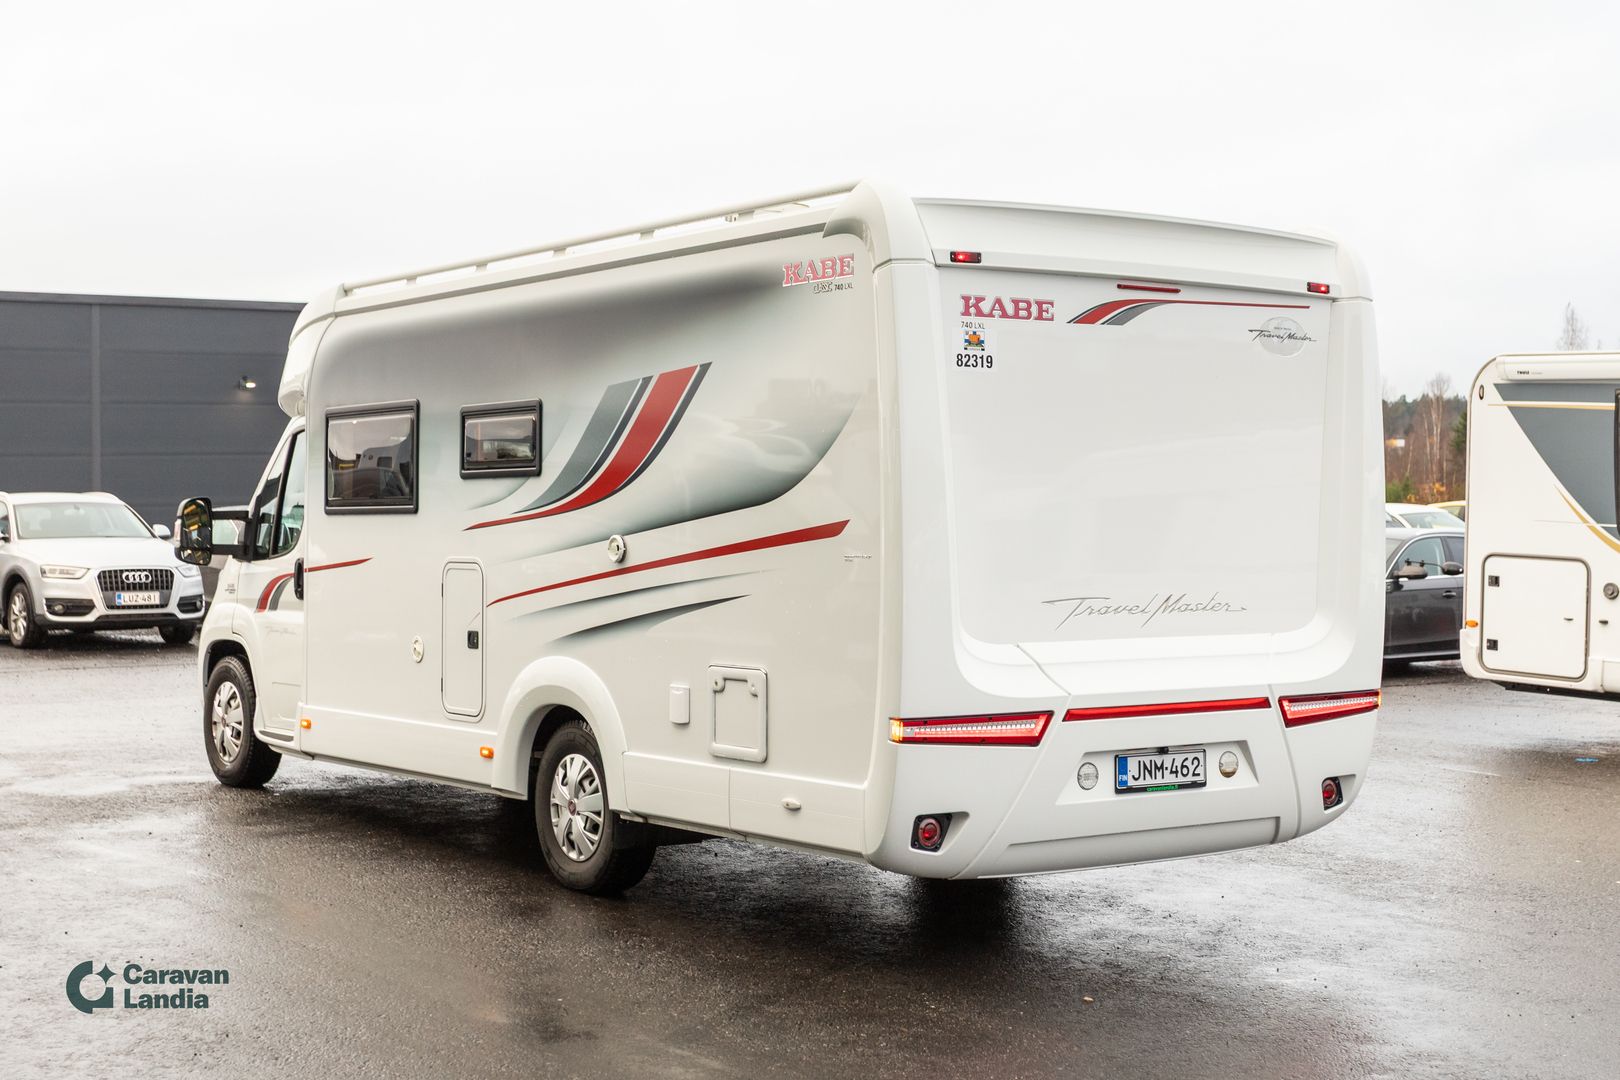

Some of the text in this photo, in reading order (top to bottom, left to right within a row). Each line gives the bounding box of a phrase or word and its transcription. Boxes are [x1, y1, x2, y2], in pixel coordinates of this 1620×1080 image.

[782, 253, 854, 287] KABE
[834, 282, 844, 292] 740
[960, 294, 1055, 322] KABE
[961, 321, 986, 330] 740 LXL
[956, 353, 994, 369] 82319
[1041, 592, 1248, 632] Travel Master
[1131, 756, 1201, 781] JNM-462
